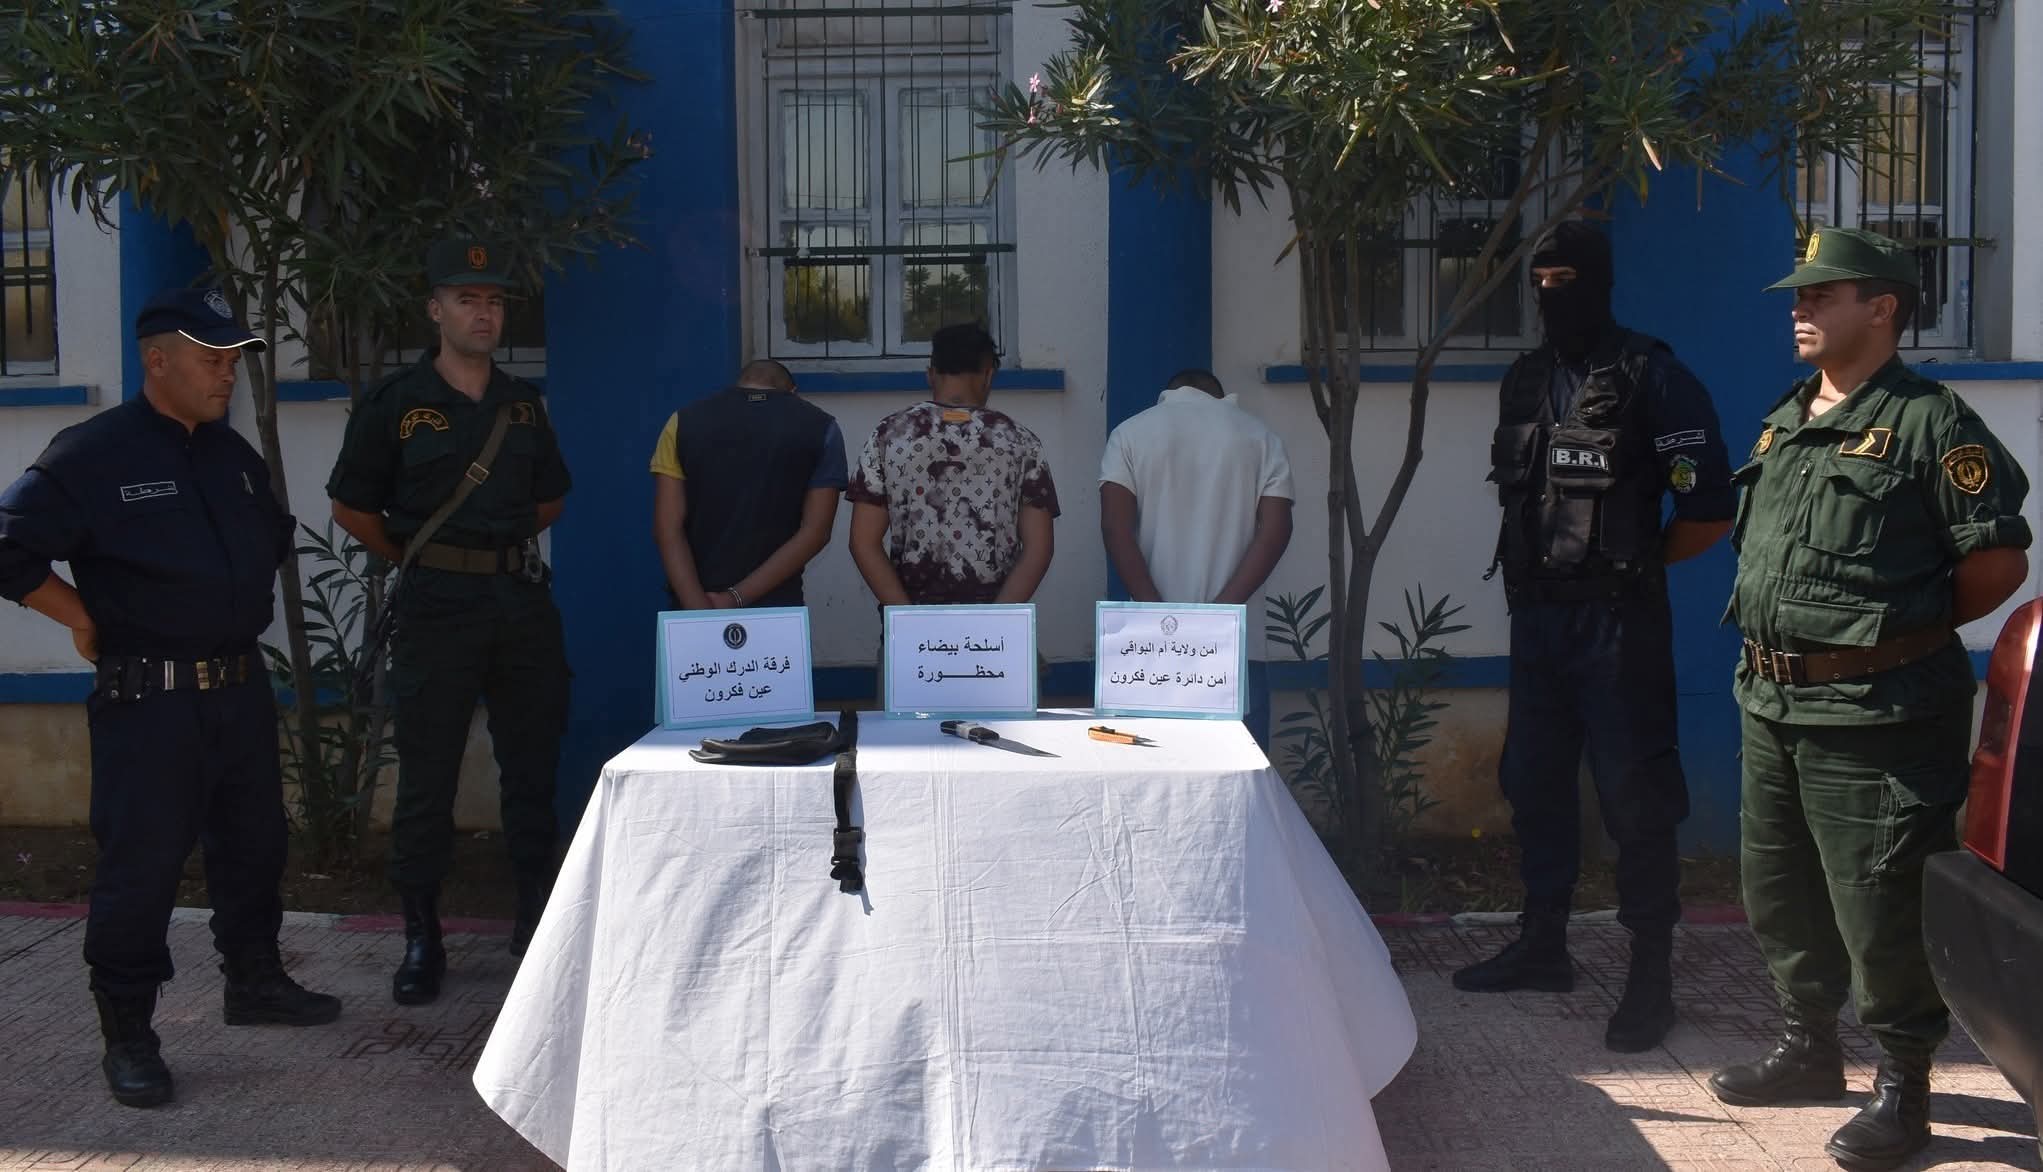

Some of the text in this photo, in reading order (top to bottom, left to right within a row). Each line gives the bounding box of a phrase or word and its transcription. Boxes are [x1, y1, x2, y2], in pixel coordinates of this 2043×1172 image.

[1557, 450, 1605, 468] B.R.I
[918, 636, 1004, 655] أسلحة بيضاء
[1121, 641, 1154, 656] البواقي
[1171, 641, 1196, 656] ولاية
[679, 655, 791, 682] فرقة الدرك الوطني
[1110, 669, 1145, 684] فكرون
[1149, 672, 1170, 685] عين
[705, 682, 772, 702] عين فكرون
